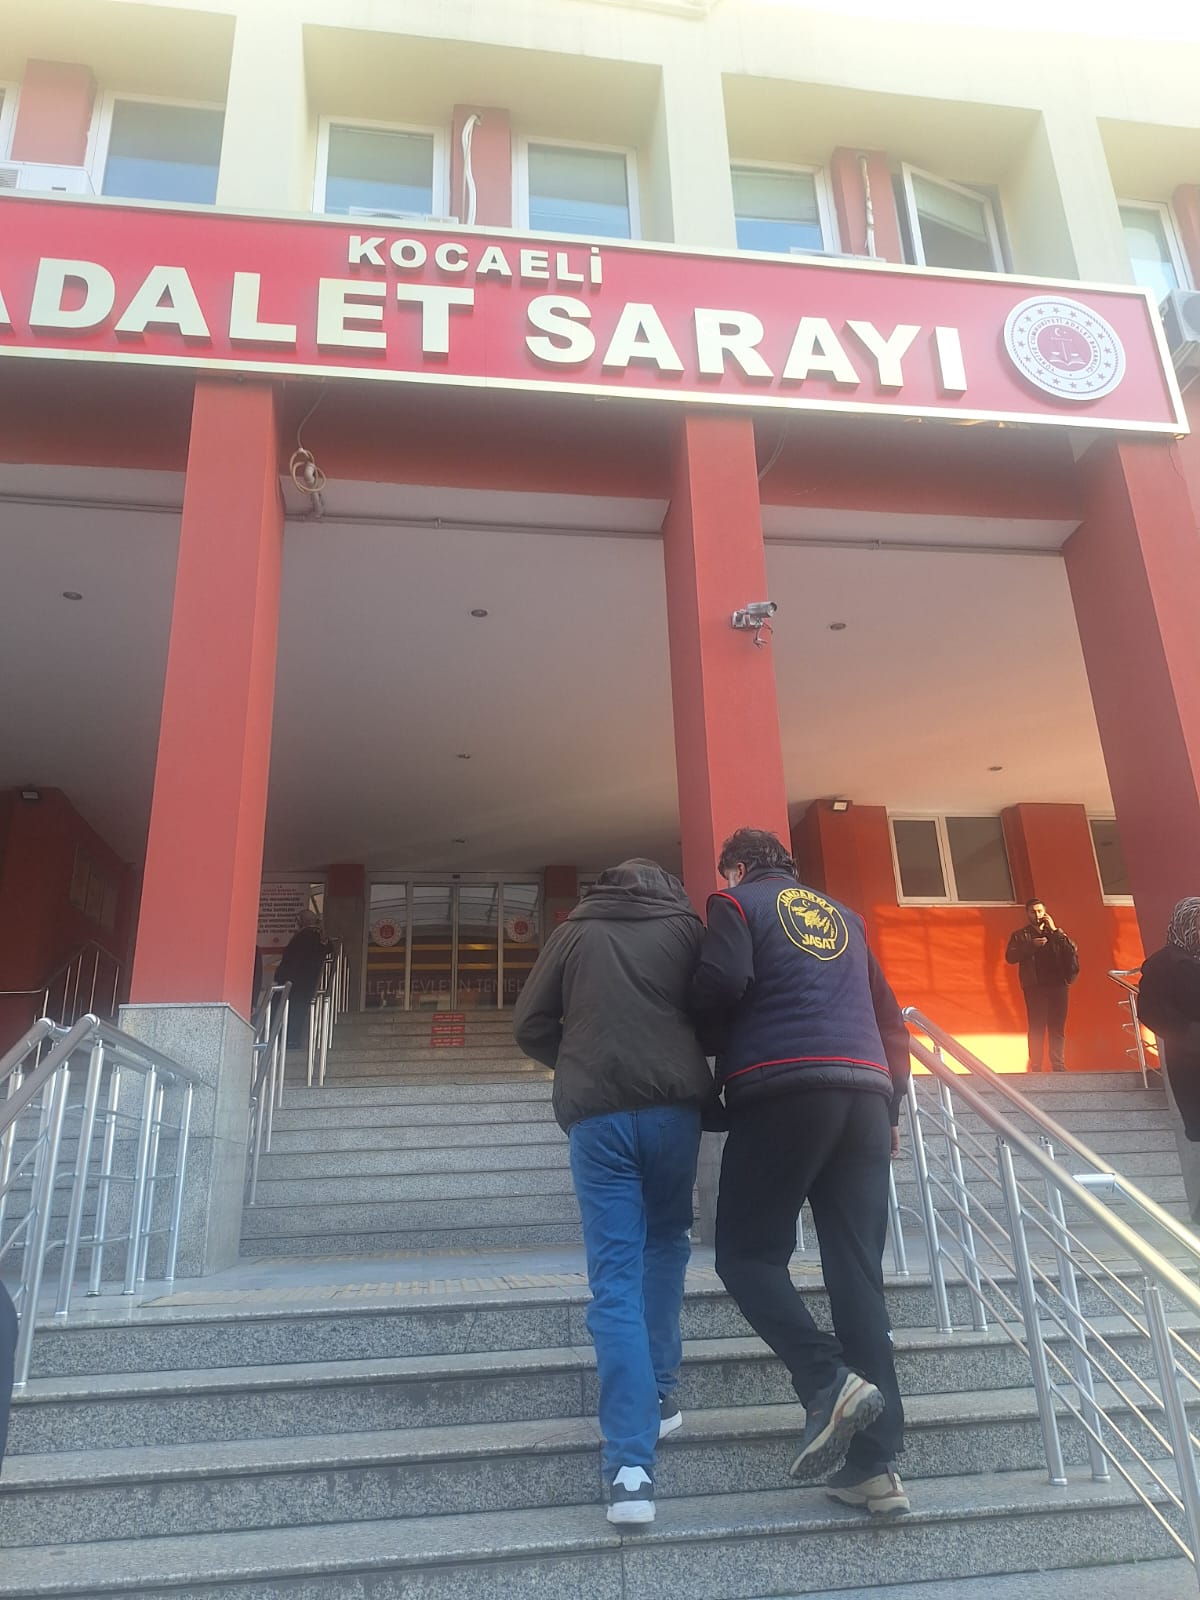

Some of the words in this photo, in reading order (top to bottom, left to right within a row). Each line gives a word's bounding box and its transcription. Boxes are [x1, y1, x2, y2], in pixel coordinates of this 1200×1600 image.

[348, 235, 603, 285] KOCAELİ
[0, 256, 475, 354] DALET
[525, 294, 967, 392] SARAYI
[780, 889, 835, 915] JANDARMA
[802, 933, 836, 950] JASAT
